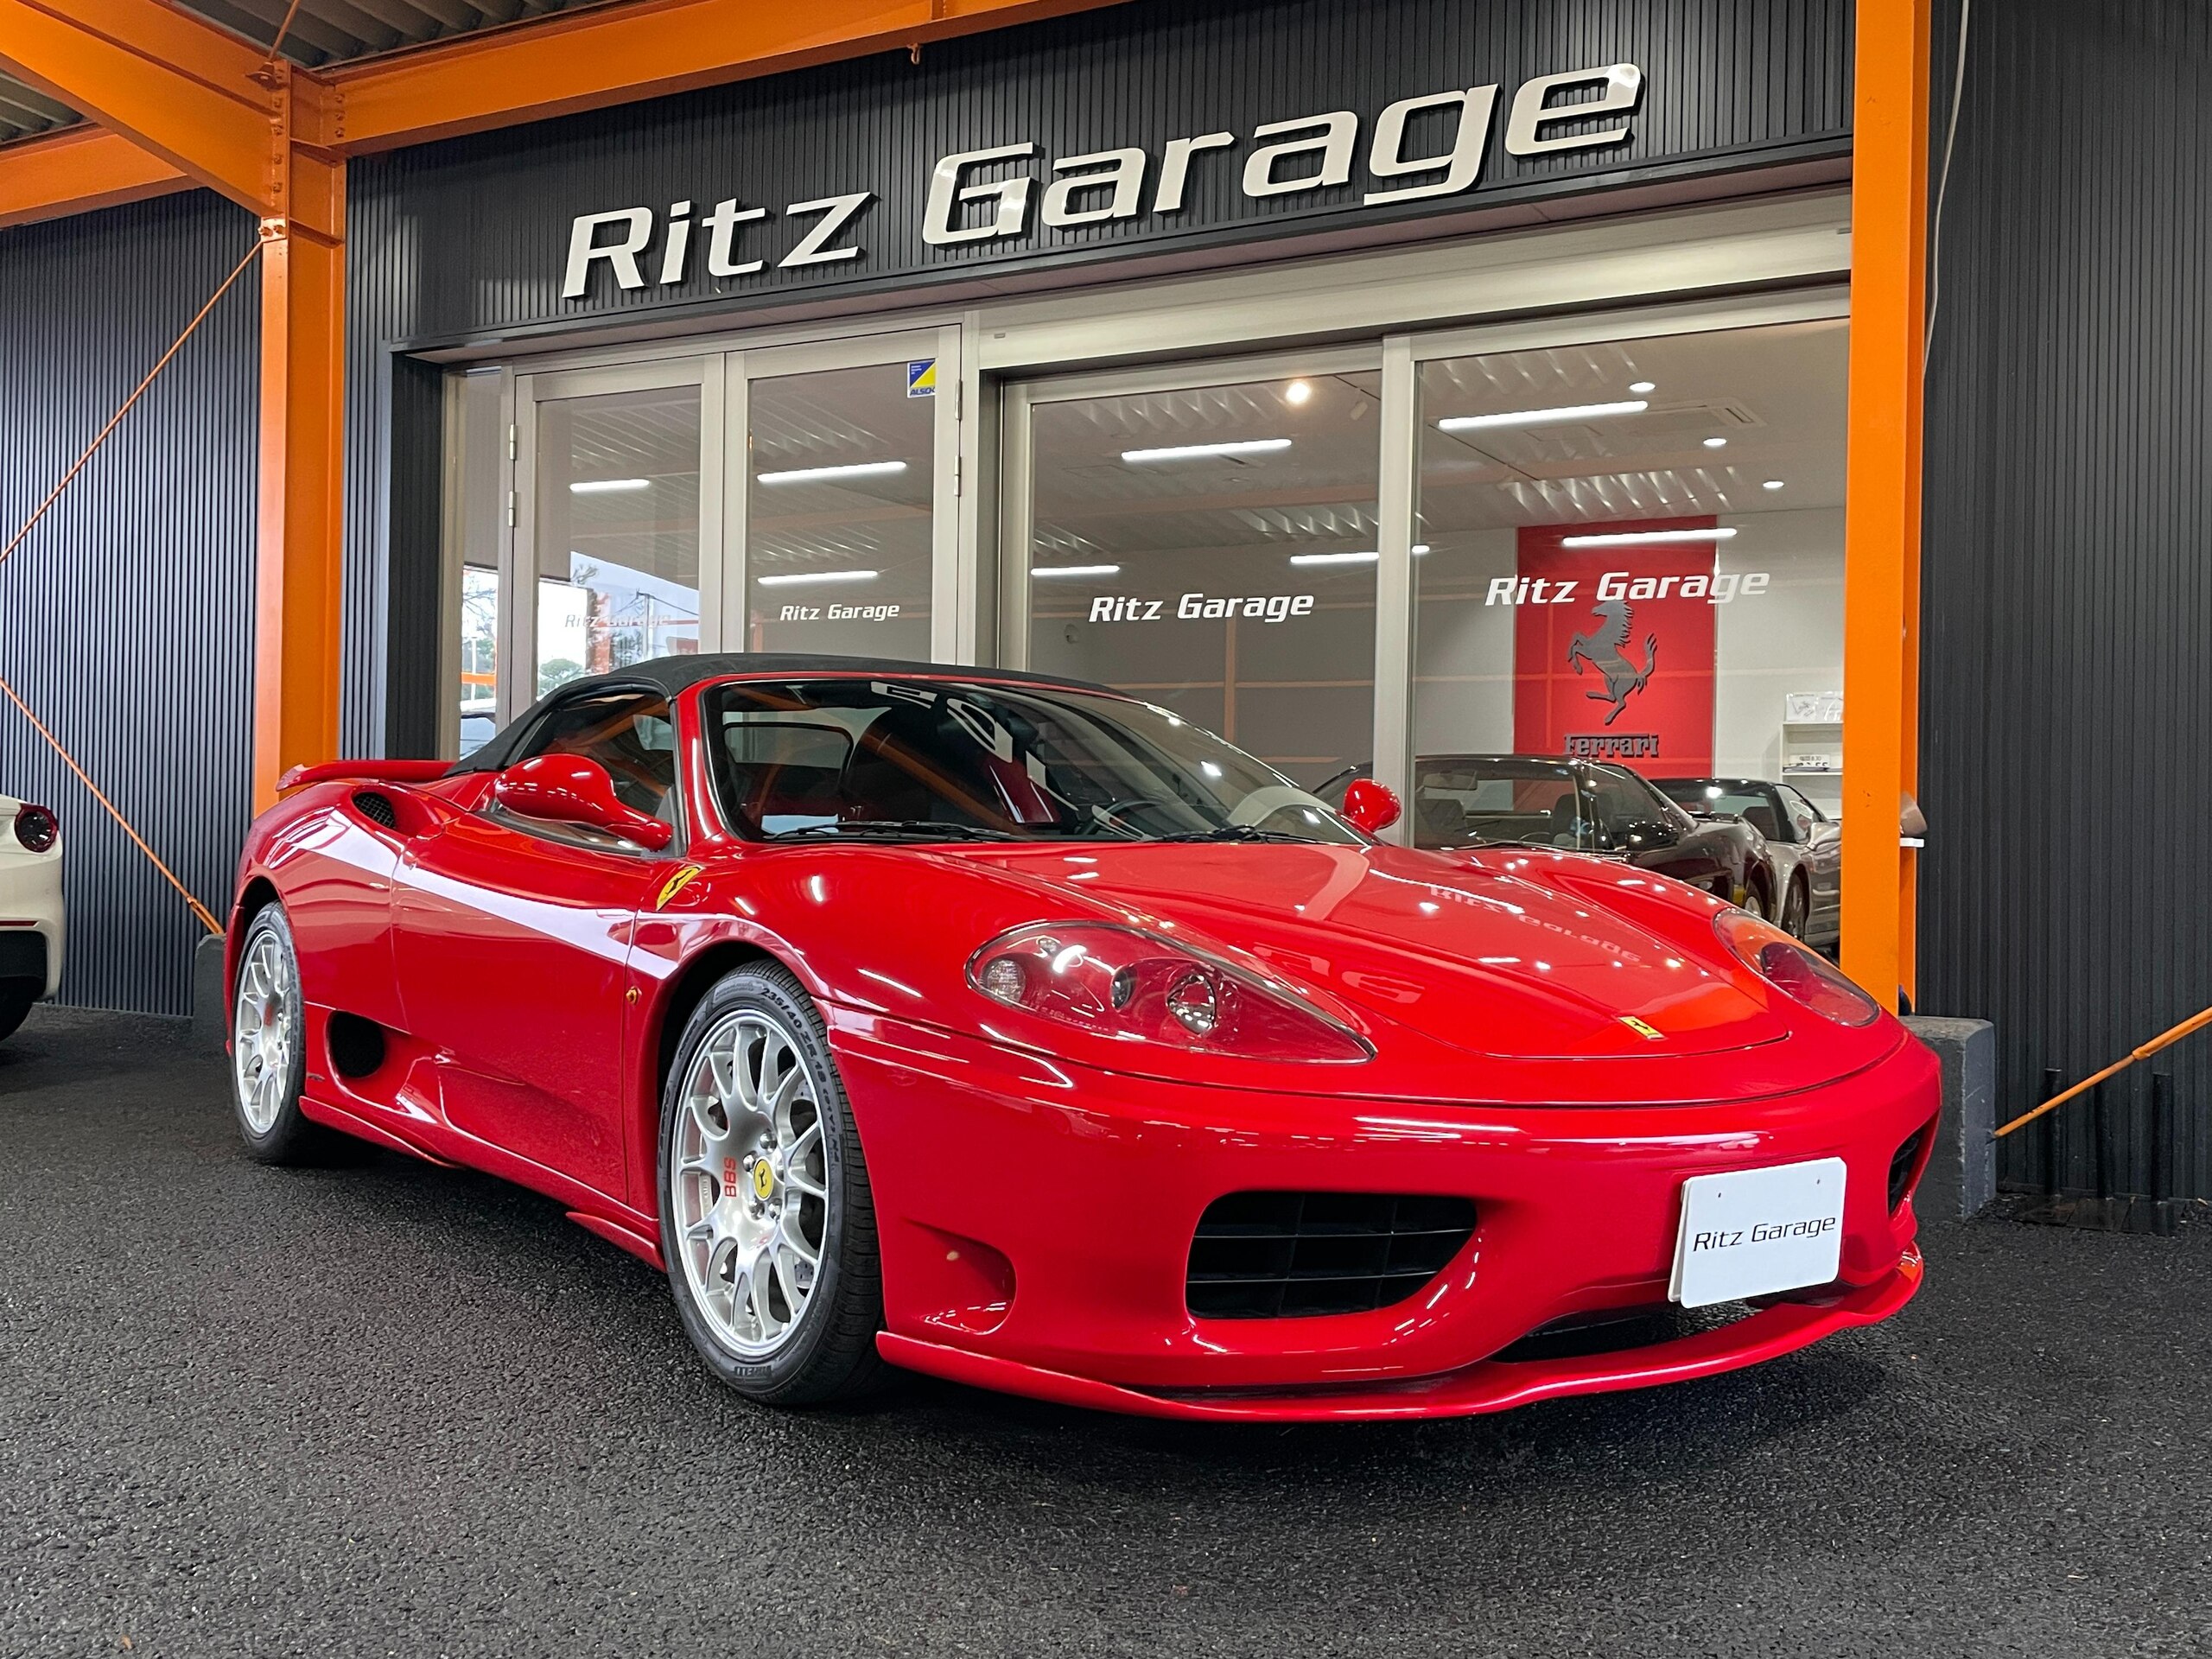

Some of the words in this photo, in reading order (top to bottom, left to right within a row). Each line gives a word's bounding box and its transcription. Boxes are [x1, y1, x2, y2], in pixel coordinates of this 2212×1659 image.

[562, 191, 873, 299] Ritz
[921, 62, 1643, 245] Garage
[1486, 575, 1579, 606] Ritz
[1596, 571, 1770, 604] Garage
[780, 605, 821, 621] Ritz
[827, 603, 900, 621] Garage
[1088, 596, 1164, 622] Ritz
[1177, 593, 1314, 623] Garage
[1562, 733, 1659, 758] Ferrari
[723, 1156, 737, 1198] BBS
[1693, 1231, 1744, 1252] Ritz
[1751, 1217, 1836, 1243] Garage
